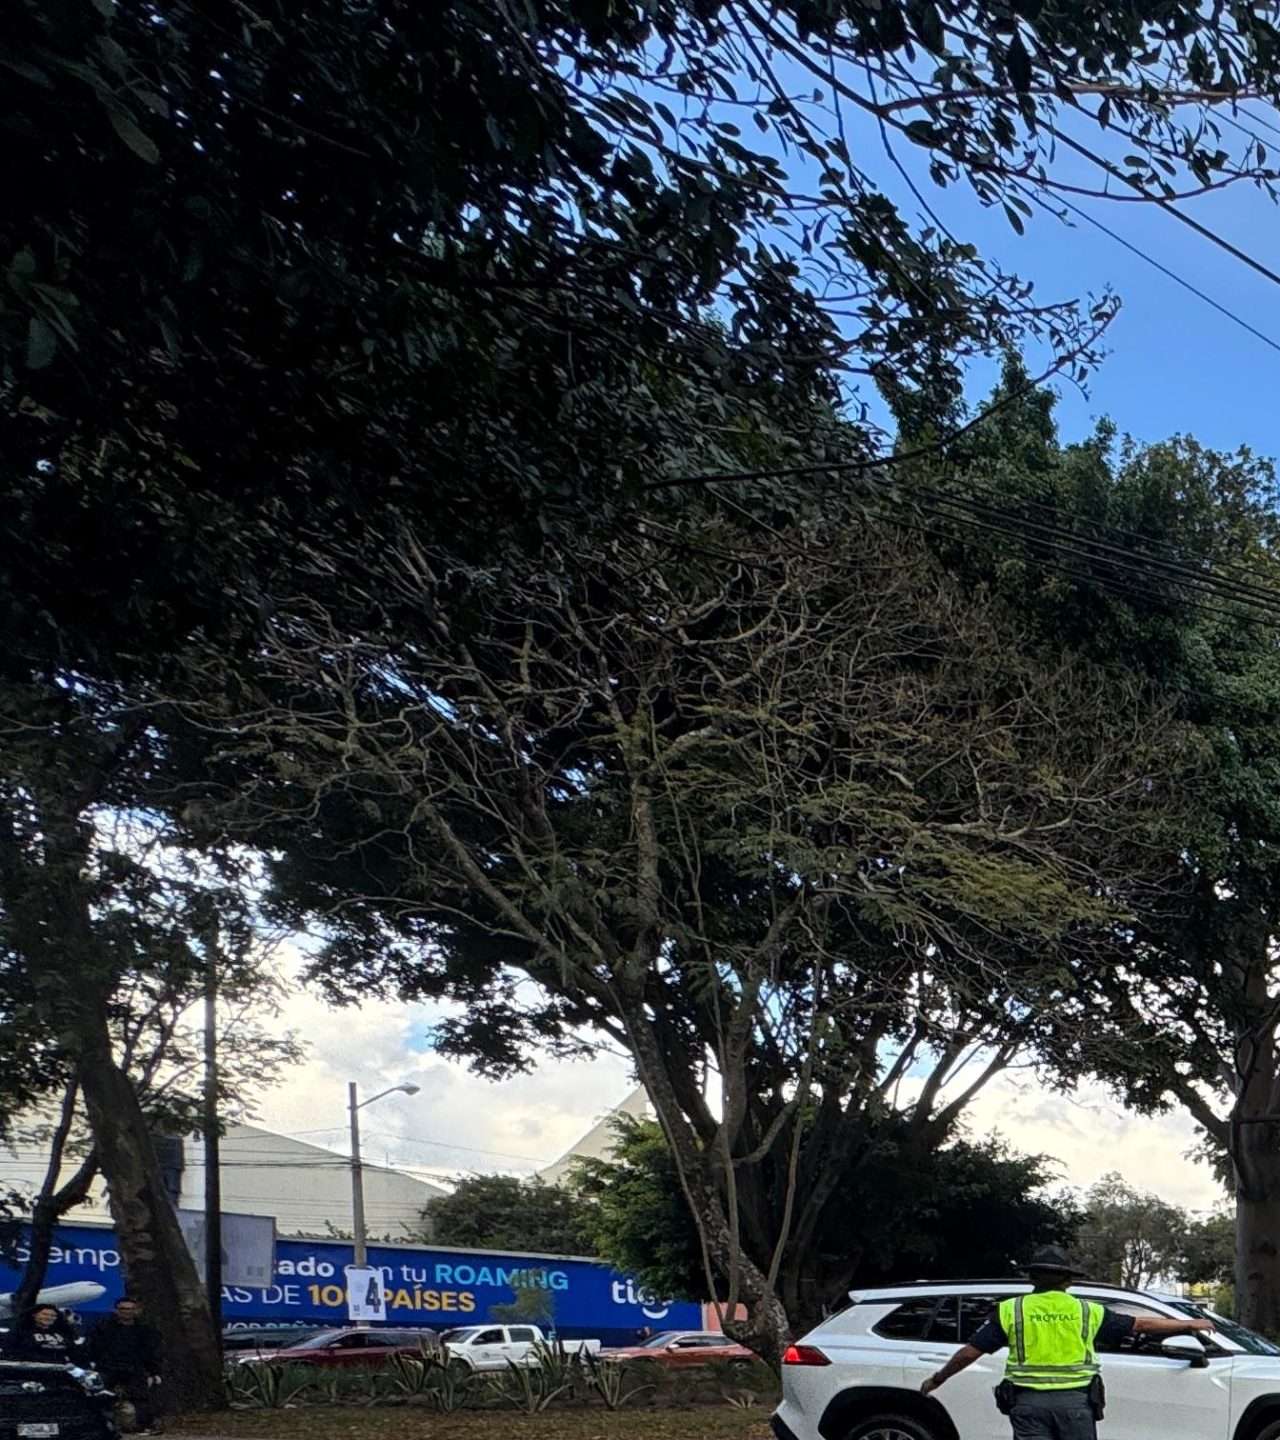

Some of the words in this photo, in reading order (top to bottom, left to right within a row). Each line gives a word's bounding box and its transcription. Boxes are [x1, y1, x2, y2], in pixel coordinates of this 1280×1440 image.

[273, 1256, 335, 1278] ado
[401, 1264, 427, 1282] tu
[435, 1263, 569, 1290] ROAMING
[221, 1285, 253, 1304] AS
[262, 1284, 302, 1305] DE
[308, 1283, 348, 1308] 10
[365, 1277, 381, 1313] 4
[1030, 1313, 1078, 1322] PROVIAL
